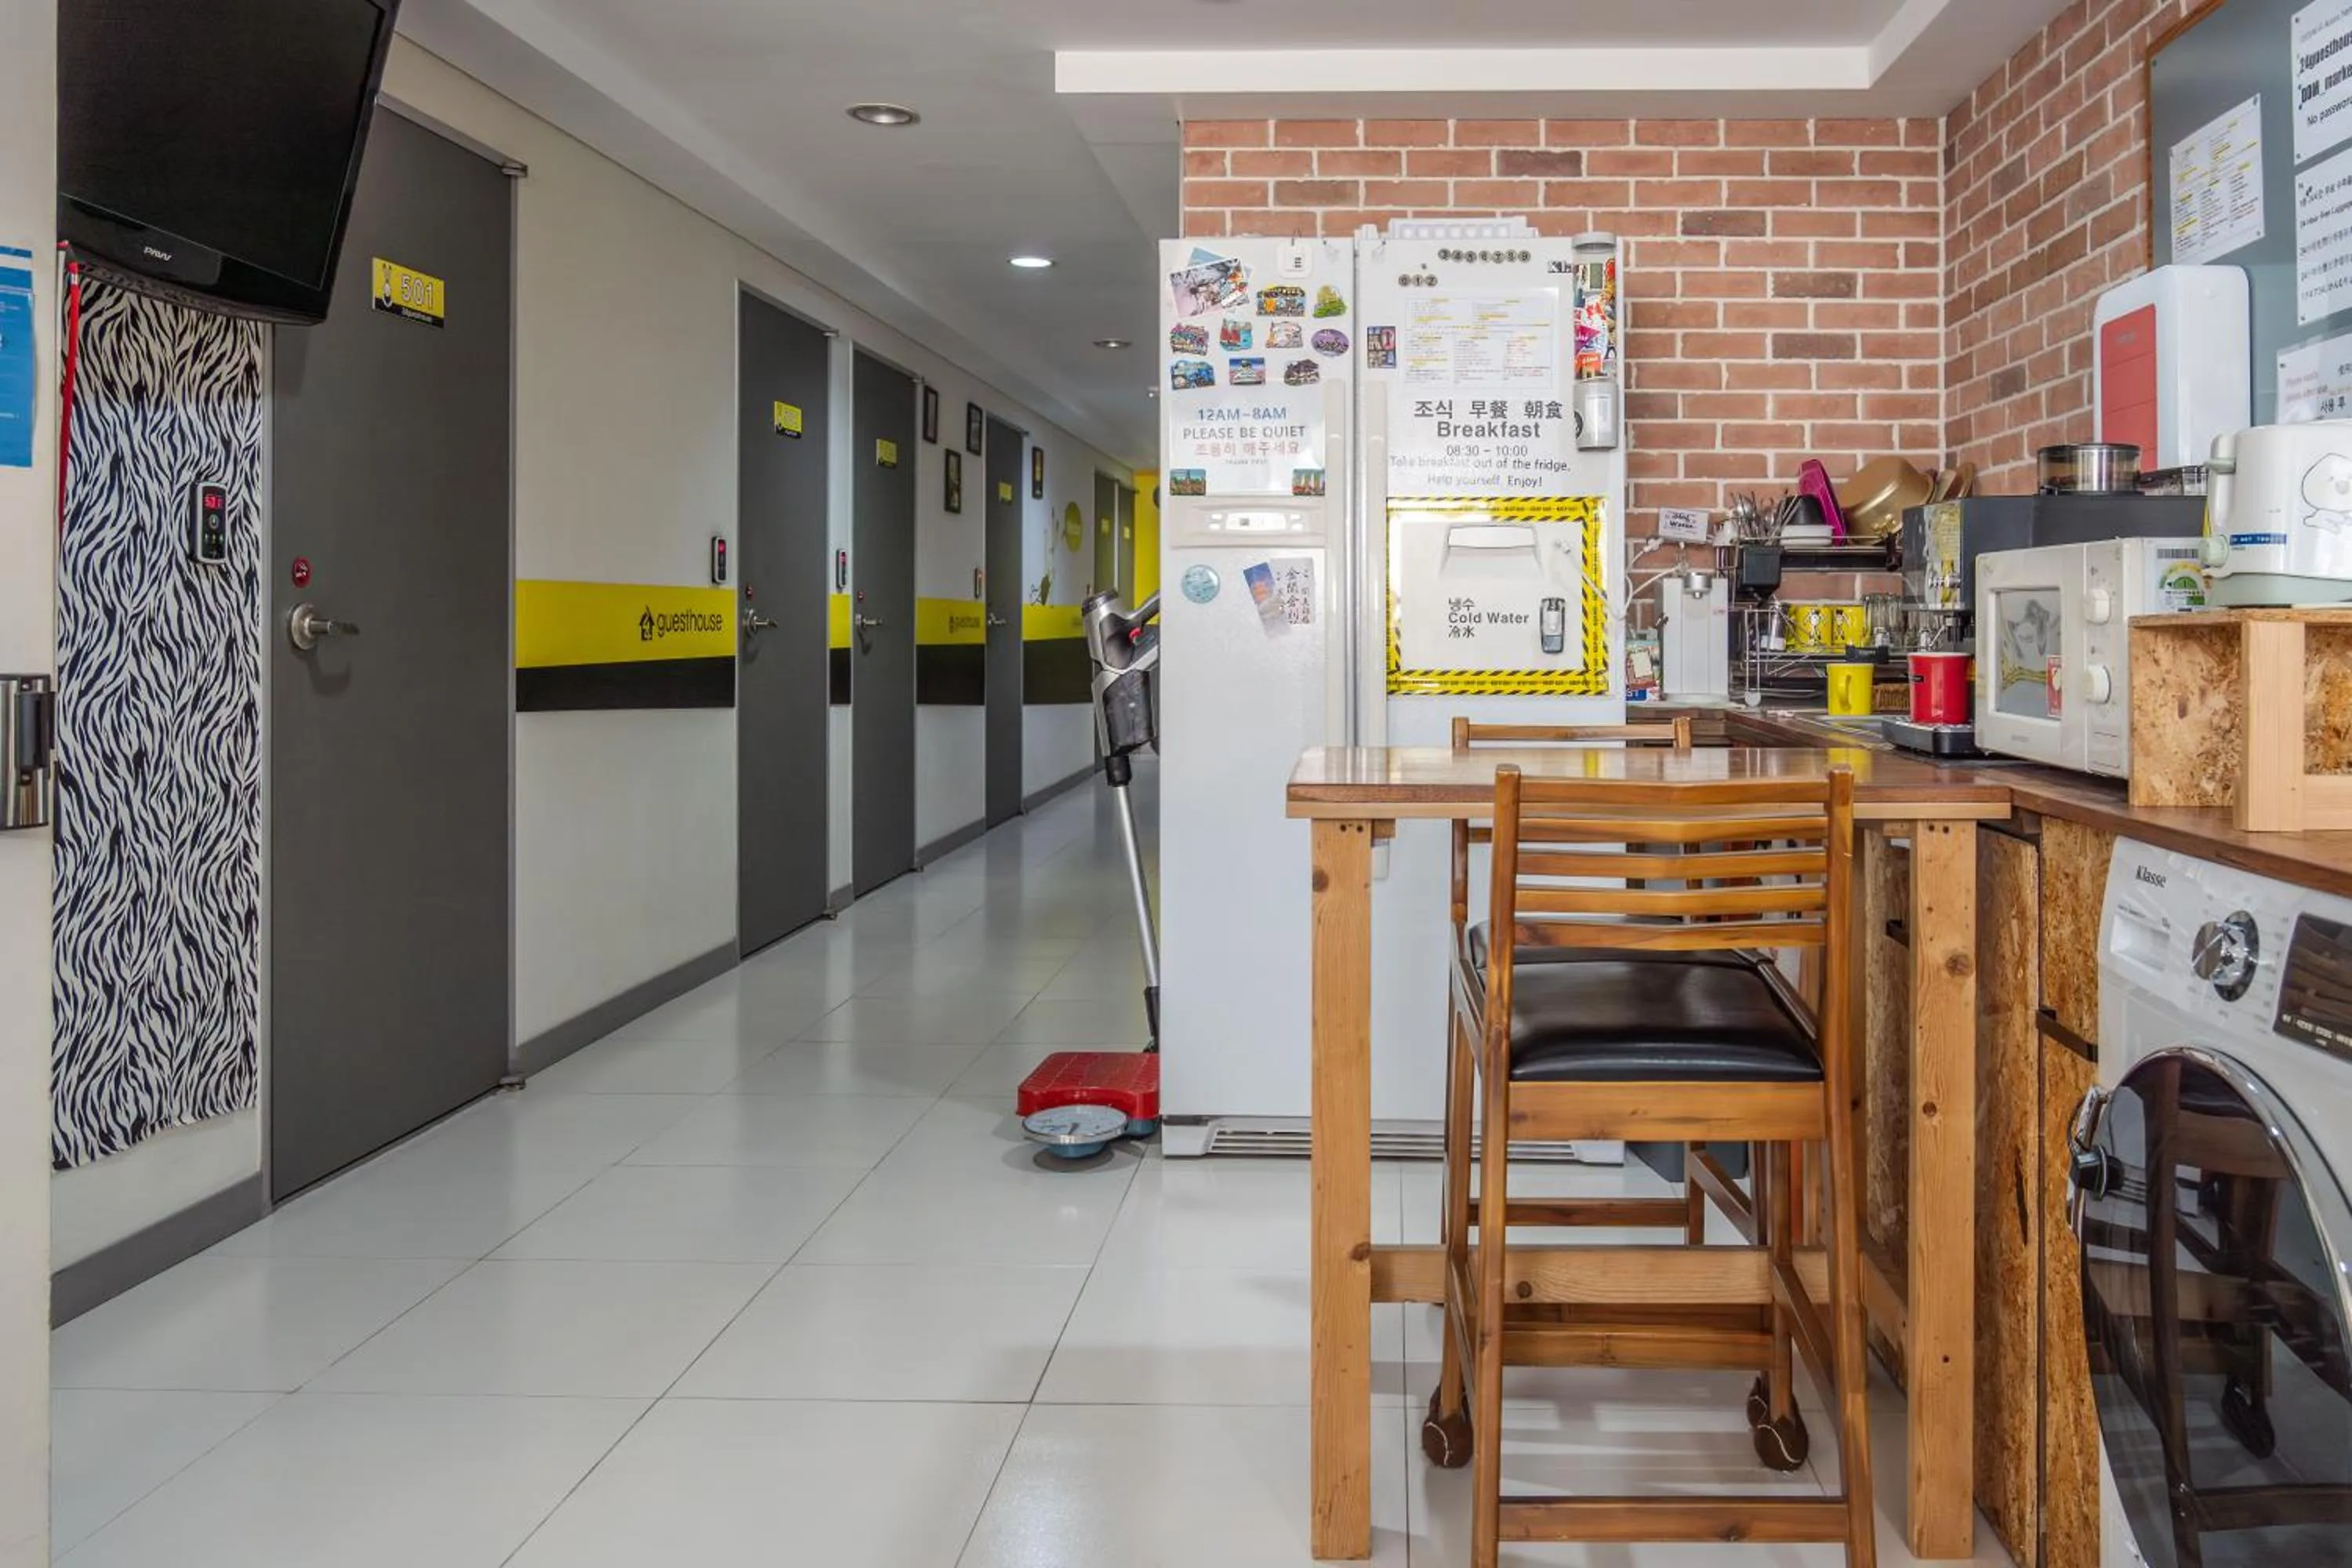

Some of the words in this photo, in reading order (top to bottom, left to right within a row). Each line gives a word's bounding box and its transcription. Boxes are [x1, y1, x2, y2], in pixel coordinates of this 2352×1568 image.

[401, 274, 434, 310] 501
[1414, 400, 1454, 419] 조식
[1469, 401, 1508, 419] 早餐
[1524, 401, 1563, 419] 朝食
[1182, 427, 1234, 440] PLEASE
[1240, 426, 1258, 438] BE
[1262, 426, 1306, 438] QUIET
[1436, 421, 1541, 438] Breakfast
[1195, 442, 1236, 457] 조용히
[1243, 441, 1300, 457] 해주세요
[1446, 445, 1479, 456] 08:30
[1496, 445, 1528, 456] 10:00
[1417, 456, 1468, 467] breakfast
[1474, 458, 1494, 468] out
[1496, 458, 1508, 468] of
[1512, 459, 1531, 470] the
[1428, 474, 1453, 485] Help
[1508, 475, 1543, 488] Enjoy!
[1448, 597, 1475, 612] 냉수
[656, 608, 723, 638] guesthouse
[1448, 612, 1482, 624] Cold
[1486, 612, 1530, 624] Water
[1448, 625, 1475, 638] 冷水
[2136, 865, 2166, 888] Klasse
